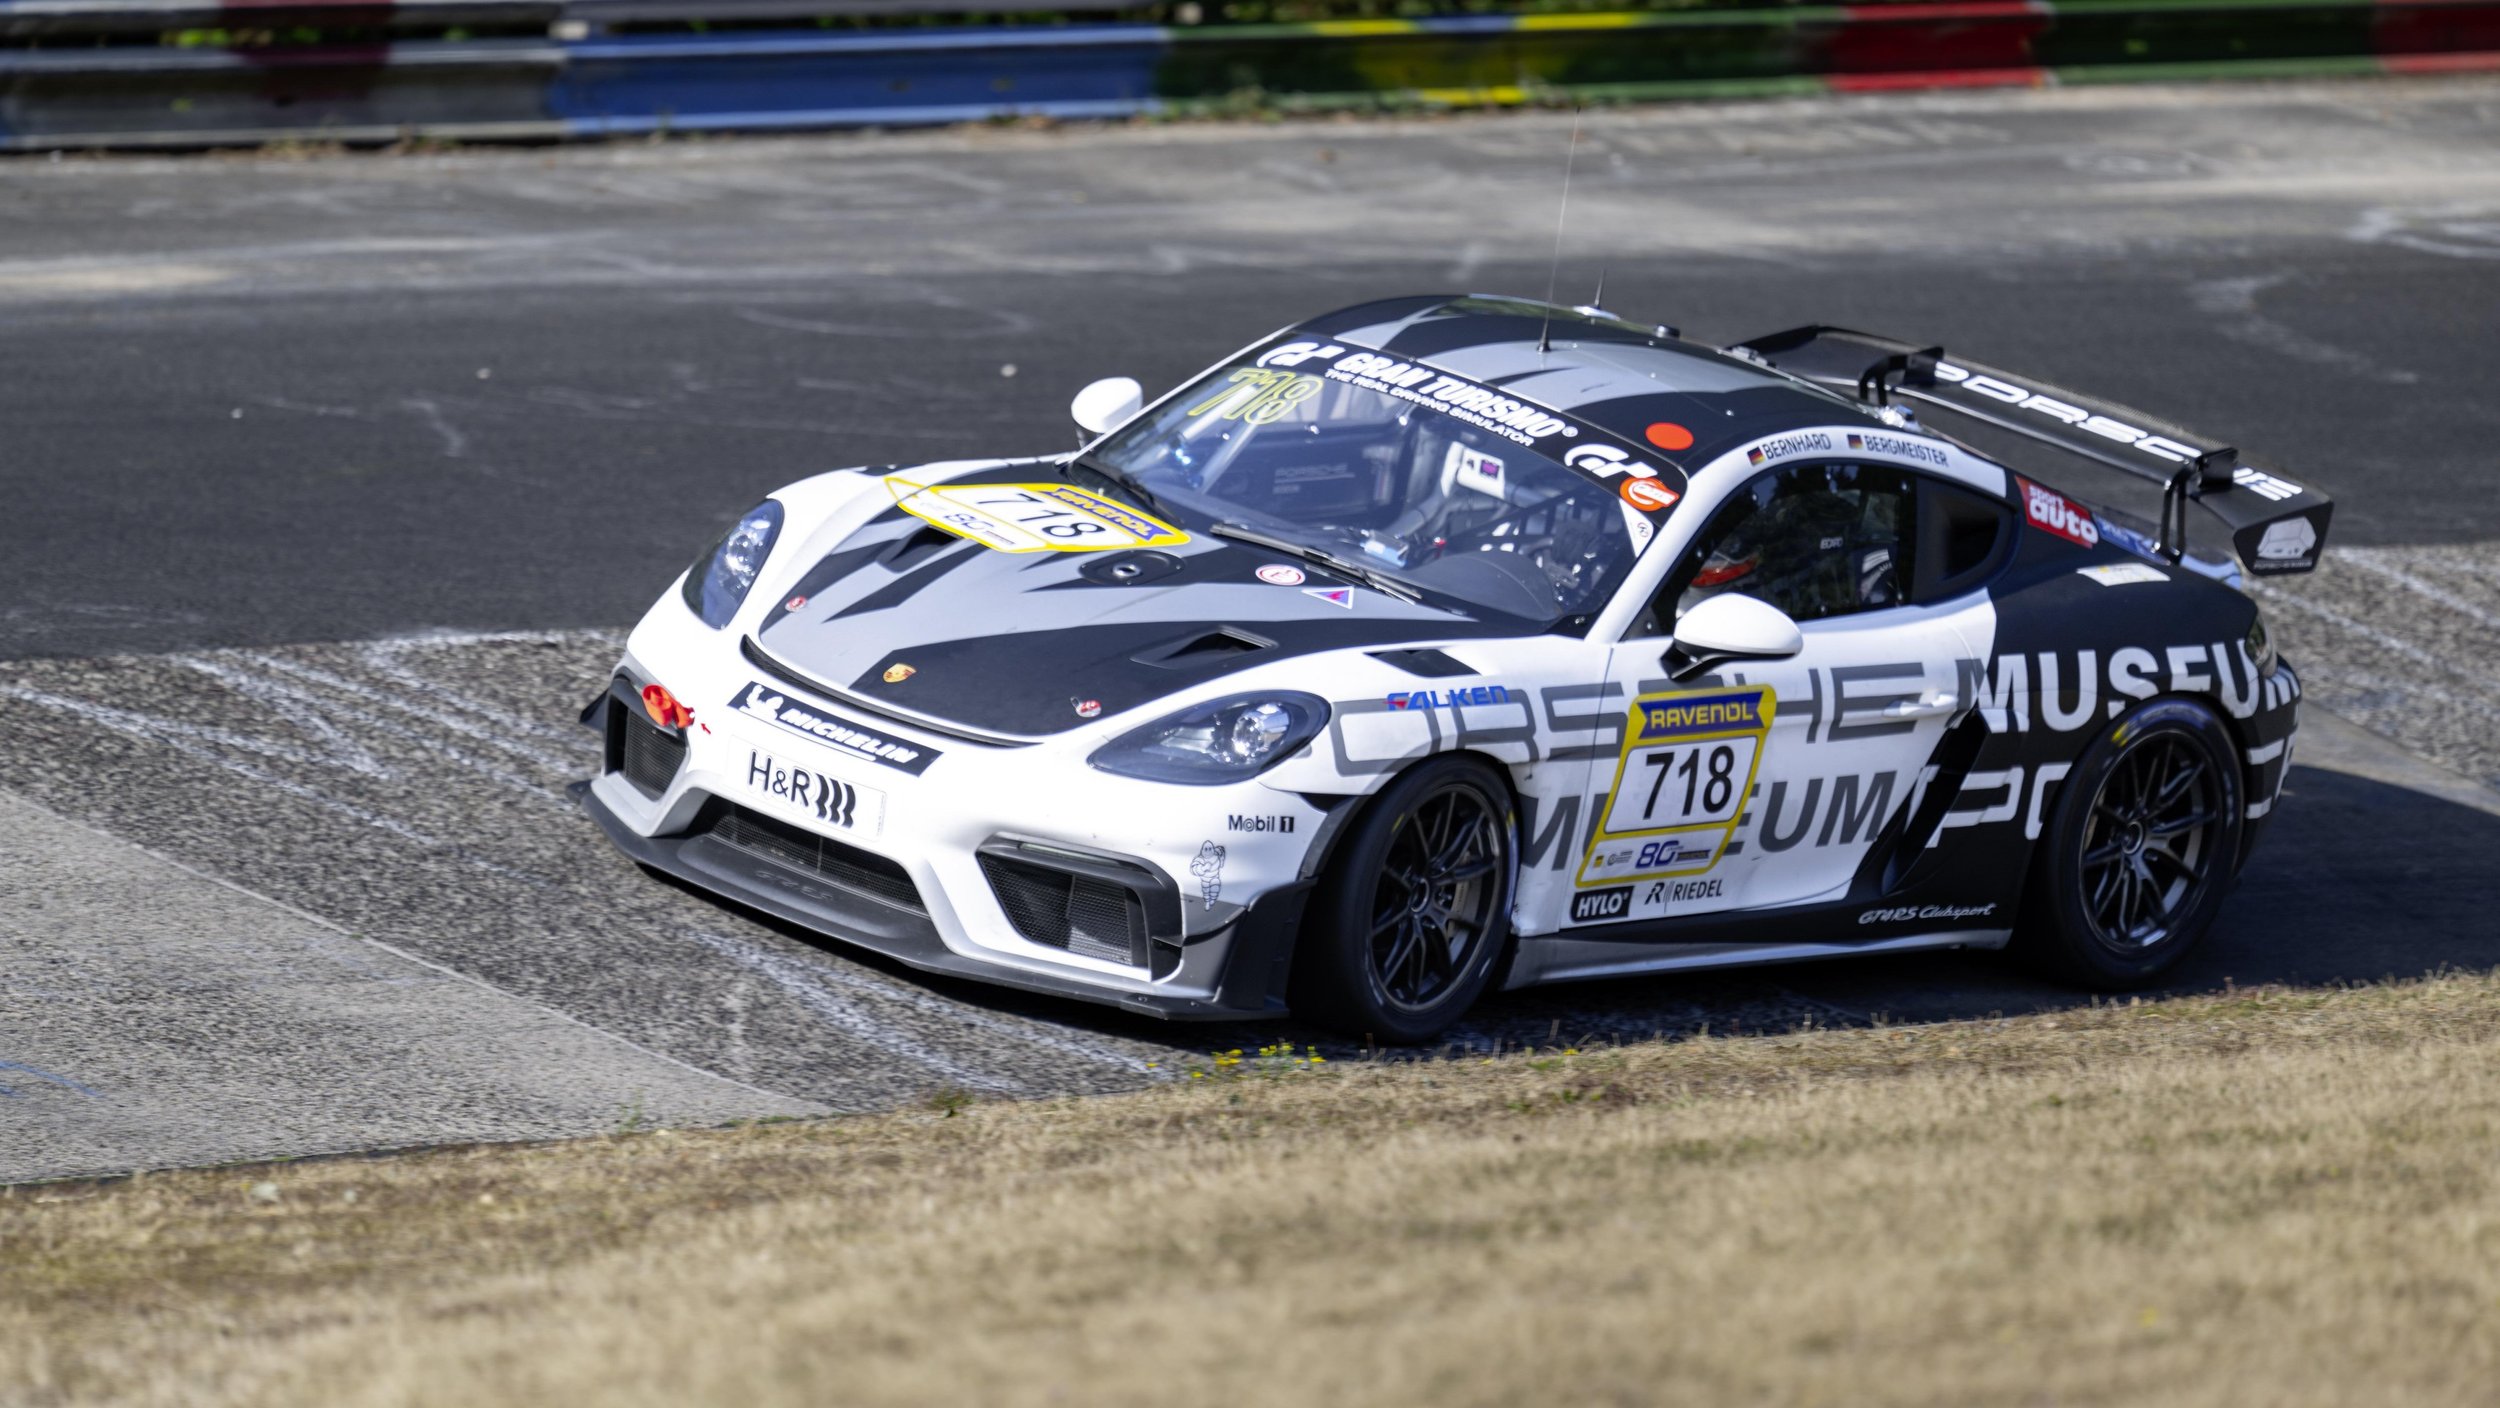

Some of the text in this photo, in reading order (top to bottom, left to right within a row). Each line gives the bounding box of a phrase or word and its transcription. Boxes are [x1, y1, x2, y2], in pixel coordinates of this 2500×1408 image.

[1333, 352, 1436, 388] GRAN
[1187, 367, 1325, 425] 718
[1325, 368, 1535, 447] THE REAL DRIVING SIMULATOR
[1762, 433, 1949, 467] BERNHARD BERGMEISTER
[976, 492, 1108, 538] 718
[1053, 490, 1154, 536] RAVENOL
[2028, 495, 2100, 545] auto
[1384, 685, 1510, 711] FALKEN
[1650, 700, 1754, 731] RAVENOL
[779, 707, 920, 764] MICHELIN
[748, 749, 811, 808] H&R
[1642, 744, 1735, 821] 718
[1228, 814, 1276, 833] Mobil
[1635, 839, 1680, 870] 80
[1672, 879, 1723, 903] RIEDEL
[1918, 902, 1997, 921] Clubsport
